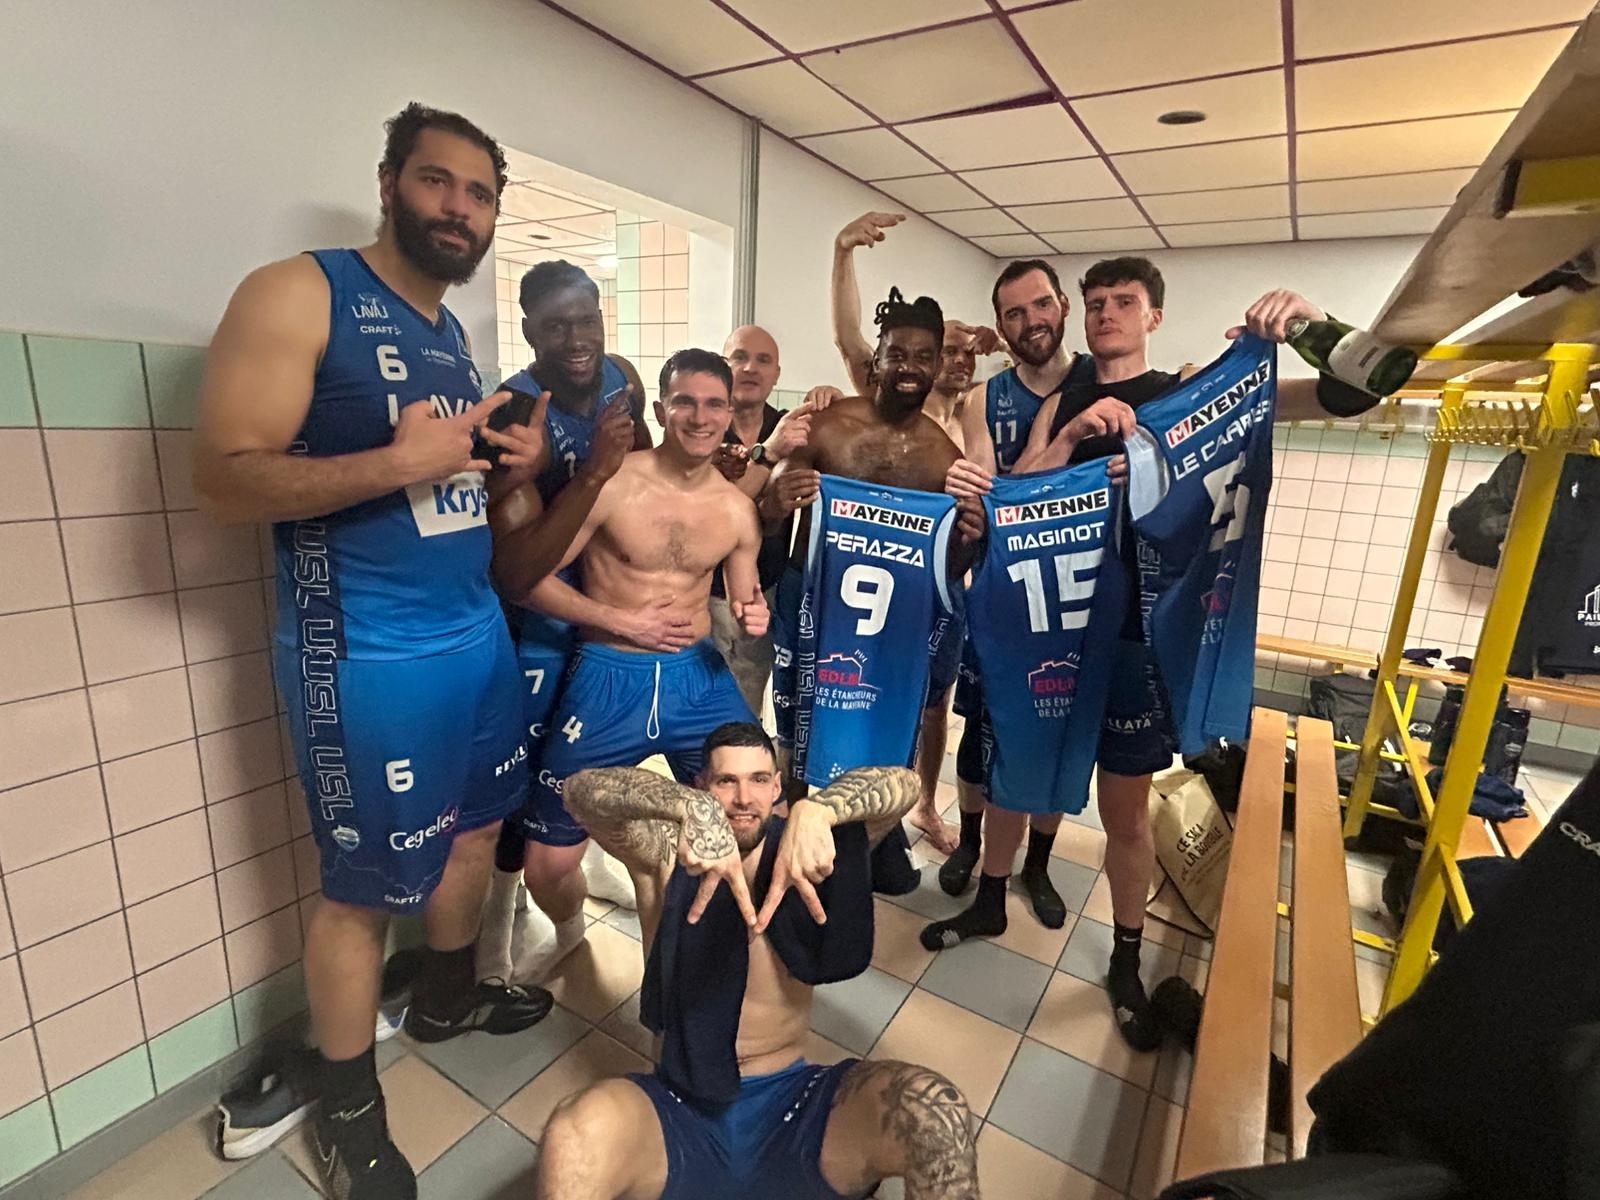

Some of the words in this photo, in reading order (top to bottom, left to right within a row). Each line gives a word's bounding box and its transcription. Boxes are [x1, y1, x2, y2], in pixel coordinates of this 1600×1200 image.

[360, 325, 393, 335] CRAFT
[376, 344, 408, 381] 6
[1167, 362, 1270, 448] MAYENNE
[1173, 452, 1200, 481] LE
[432, 482, 489, 518] Krys
[998, 490, 1107, 524] MAYENNE
[832, 499, 932, 533] MAYENNE
[826, 530, 925, 568] PERAZZA
[1007, 521, 1105, 551] MAGINOT
[840, 563, 895, 636] 9
[1006, 547, 1104, 633] 15
[525, 668, 545, 695] 7
[815, 685, 830, 697] LES
[815, 696, 826, 706] DE
[828, 699, 839, 709] LA
[1034, 698, 1052, 709] LES
[1038, 709, 1051, 718] DE
[561, 715, 584, 744] 4
[310, 745, 354, 821] USL
[385, 758, 415, 793] 6
[1176, 837, 1191, 854] CE
[1184, 851, 1200, 867] LA
